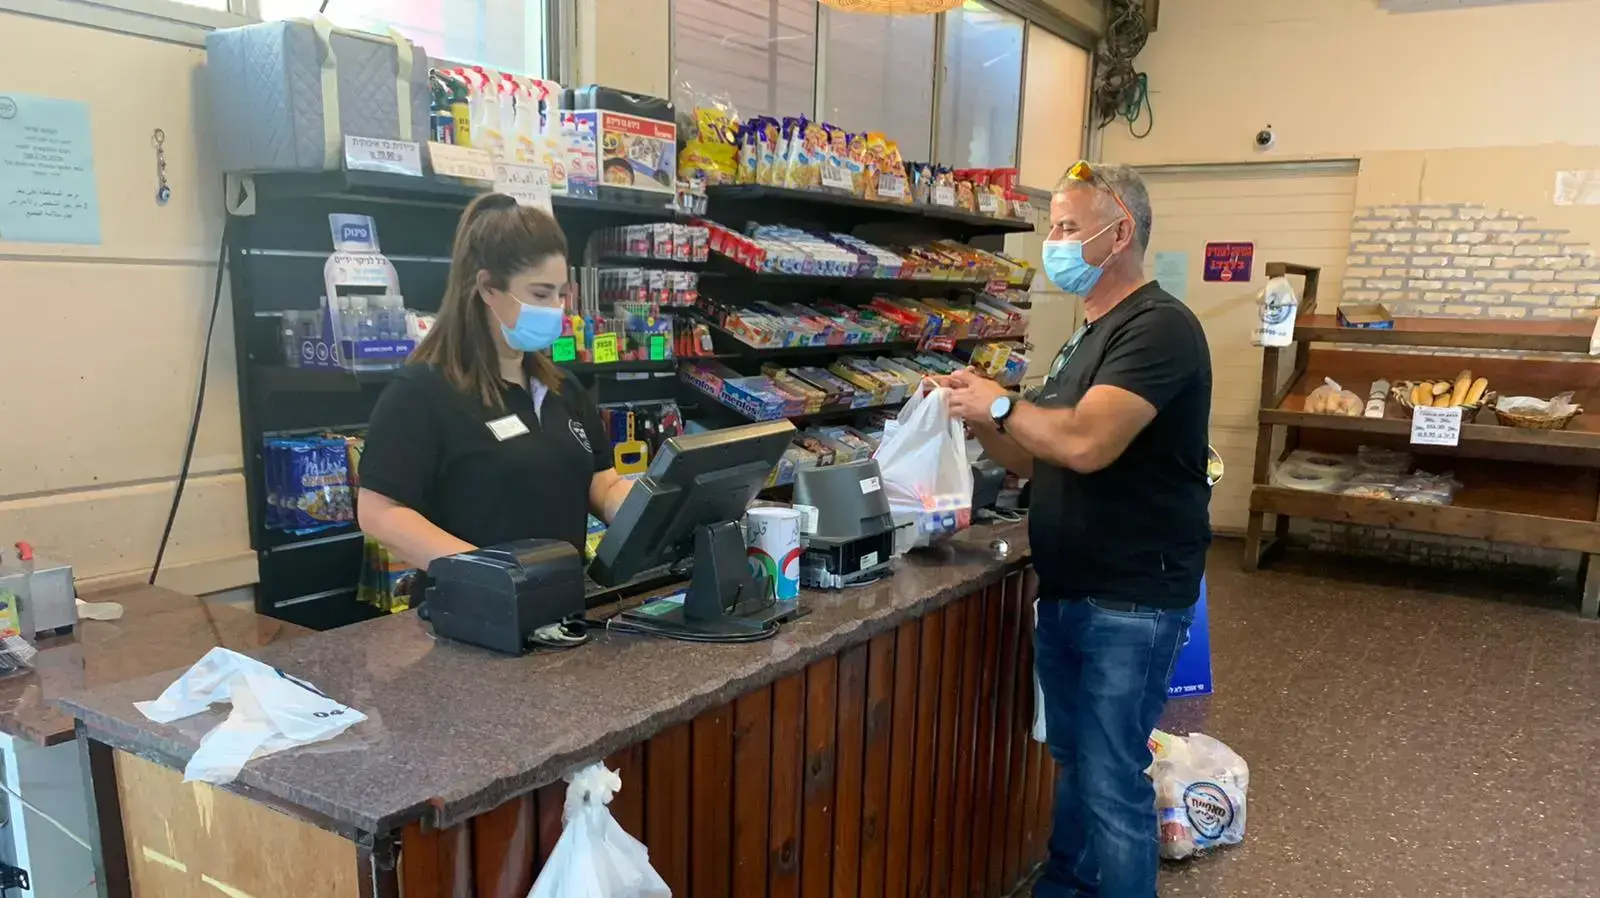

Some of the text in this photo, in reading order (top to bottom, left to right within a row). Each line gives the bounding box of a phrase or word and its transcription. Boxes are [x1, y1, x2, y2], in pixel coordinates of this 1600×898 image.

[344, 227, 367, 239] פינוק
[684, 373, 716, 394] mentos
[721, 391, 758, 416] mentos
